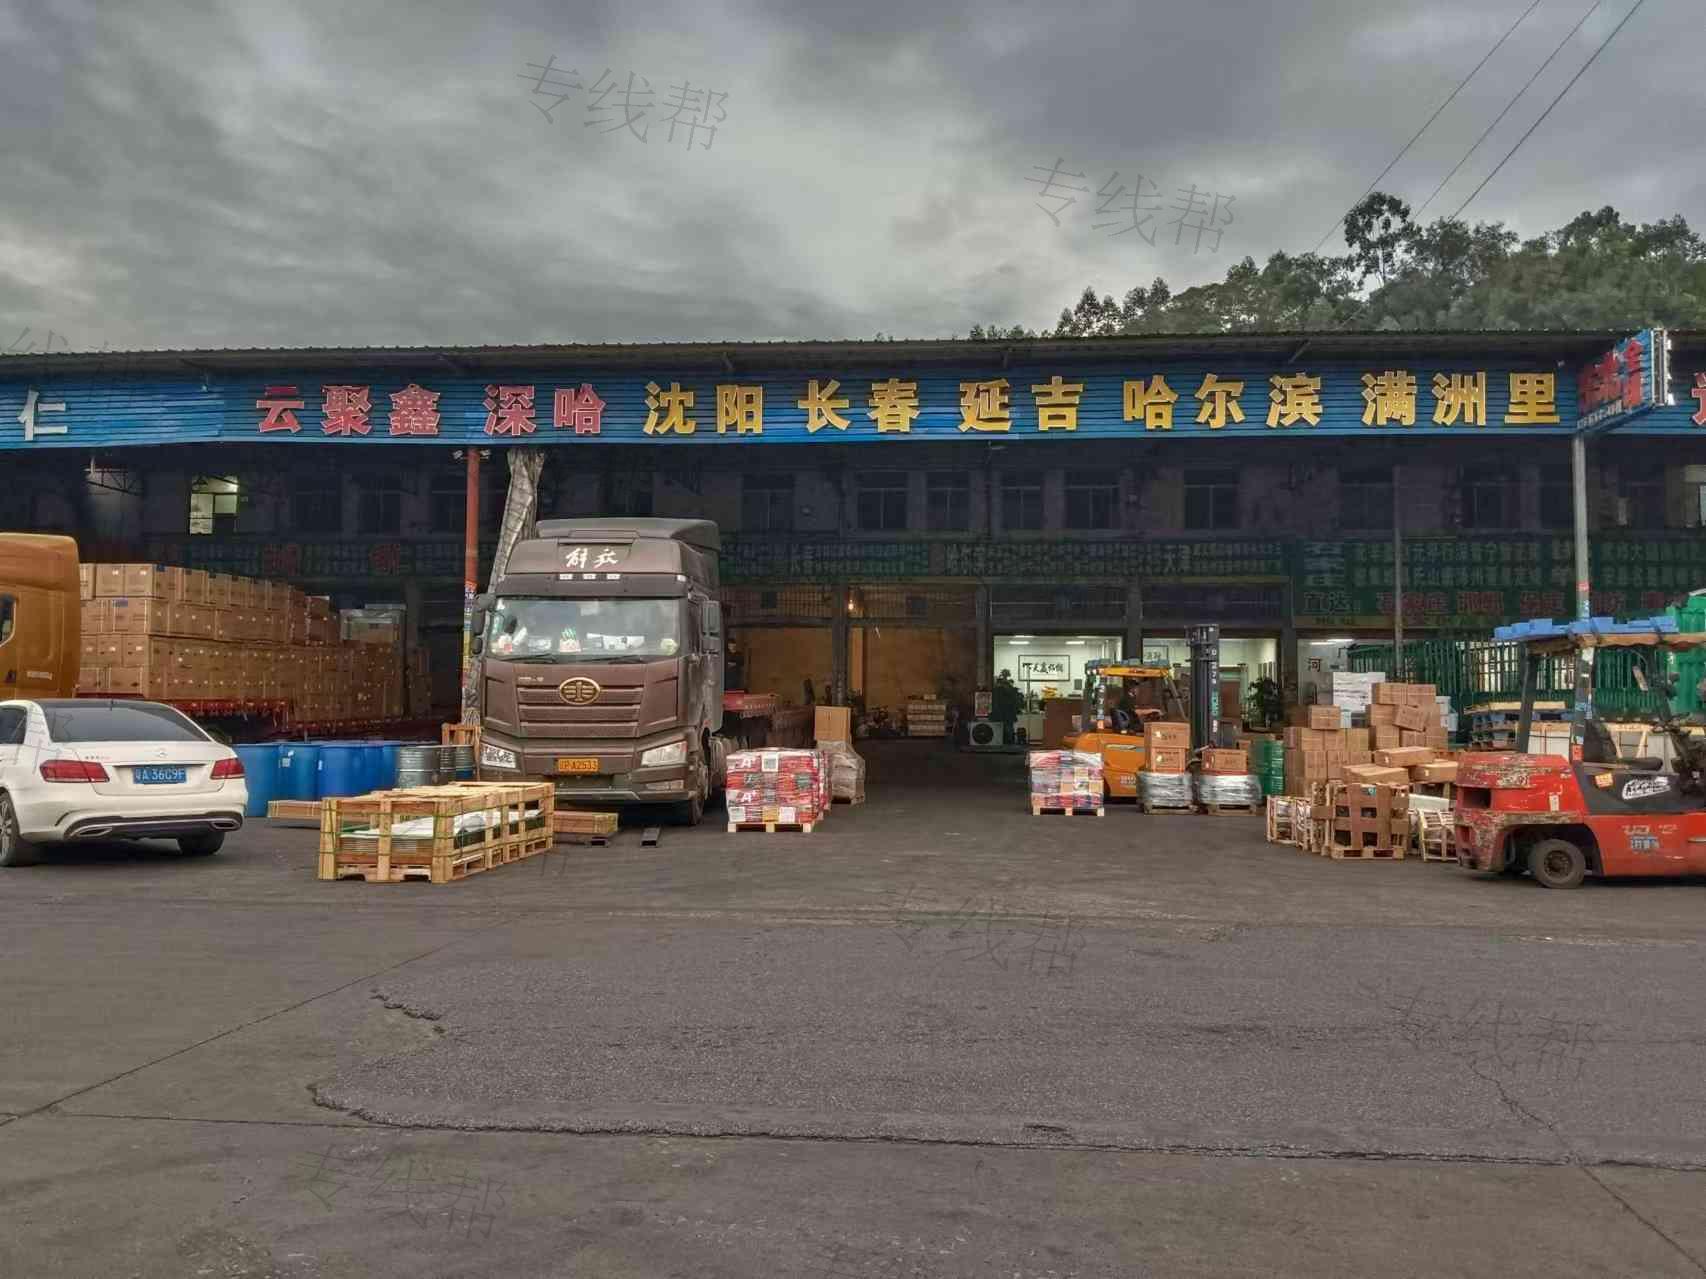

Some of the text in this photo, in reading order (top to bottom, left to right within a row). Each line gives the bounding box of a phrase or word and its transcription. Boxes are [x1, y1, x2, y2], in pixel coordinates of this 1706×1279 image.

[17, 388, 68, 441] 仁
[256, 383, 441, 436] 云聚鑫
[483, 383, 605, 436] 深哈
[643, 380, 764, 435] 沈阳
[798, 377, 921, 433] 长春
[958, 375, 1084, 433] 延吉
[1122, 372, 1324, 431] 哈尔滨
[1361, 370, 1561, 428] 满洲里
